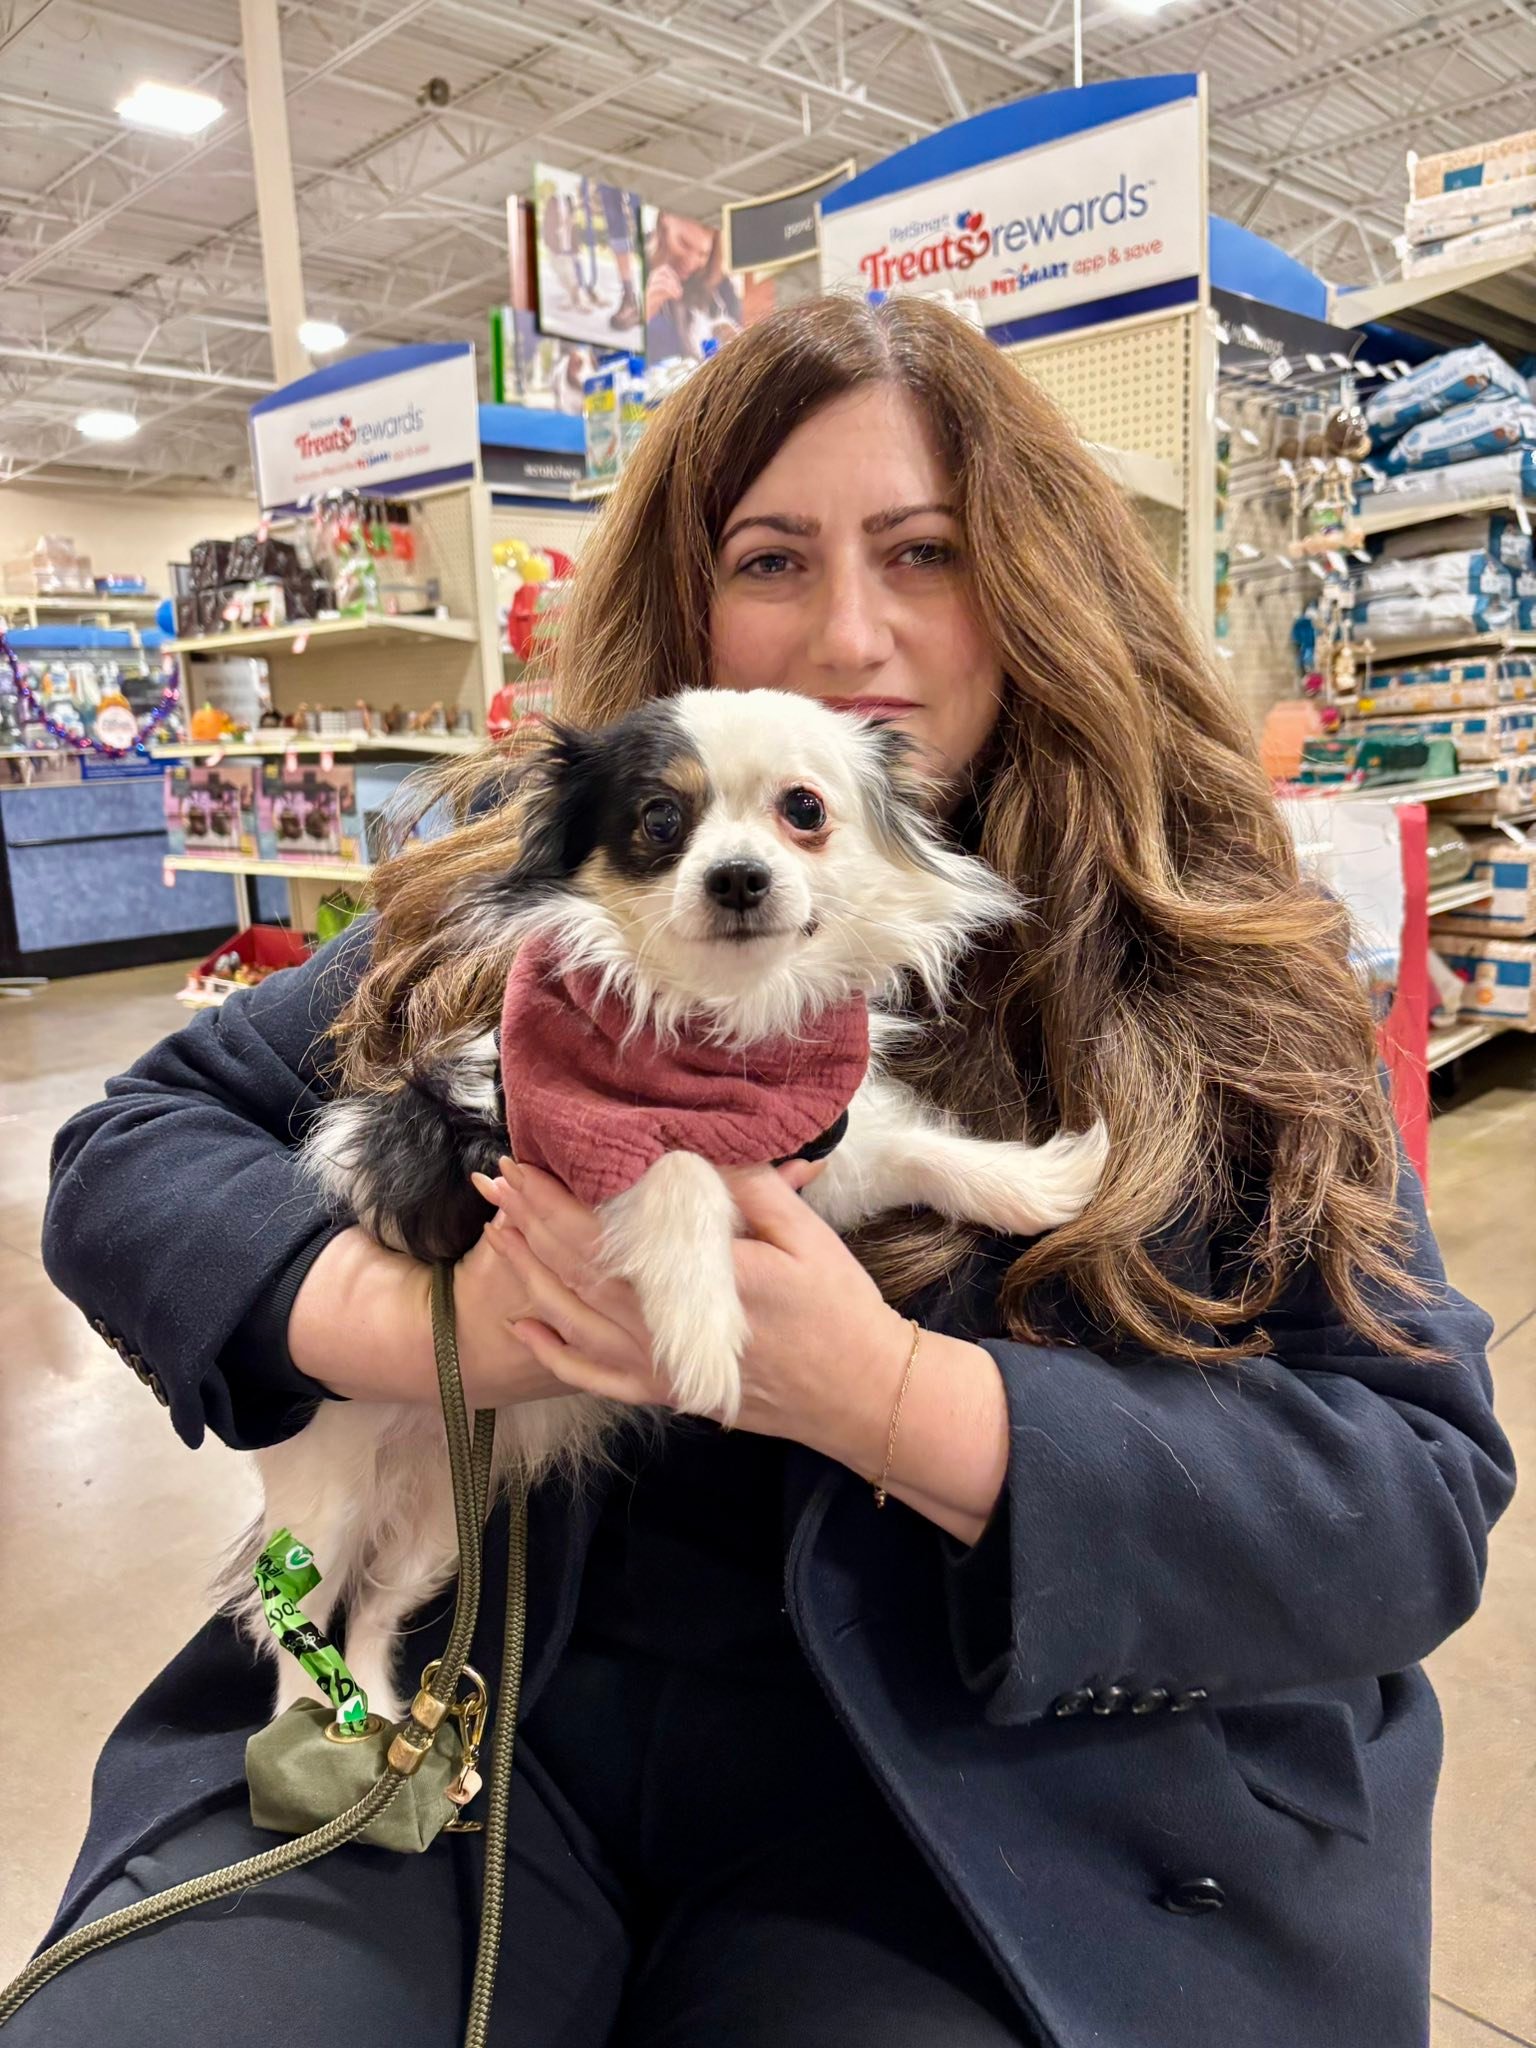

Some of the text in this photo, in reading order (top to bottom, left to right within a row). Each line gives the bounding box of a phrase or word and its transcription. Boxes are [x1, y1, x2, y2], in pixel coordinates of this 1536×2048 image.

[860, 173, 1149, 291] Treats rewards
[1072, 253, 1106, 277] app
[1108, 246, 1121, 266] &
[1123, 238, 1164, 262] save
[295, 427, 356, 459] Treats
[357, 401, 425, 446] rewards
